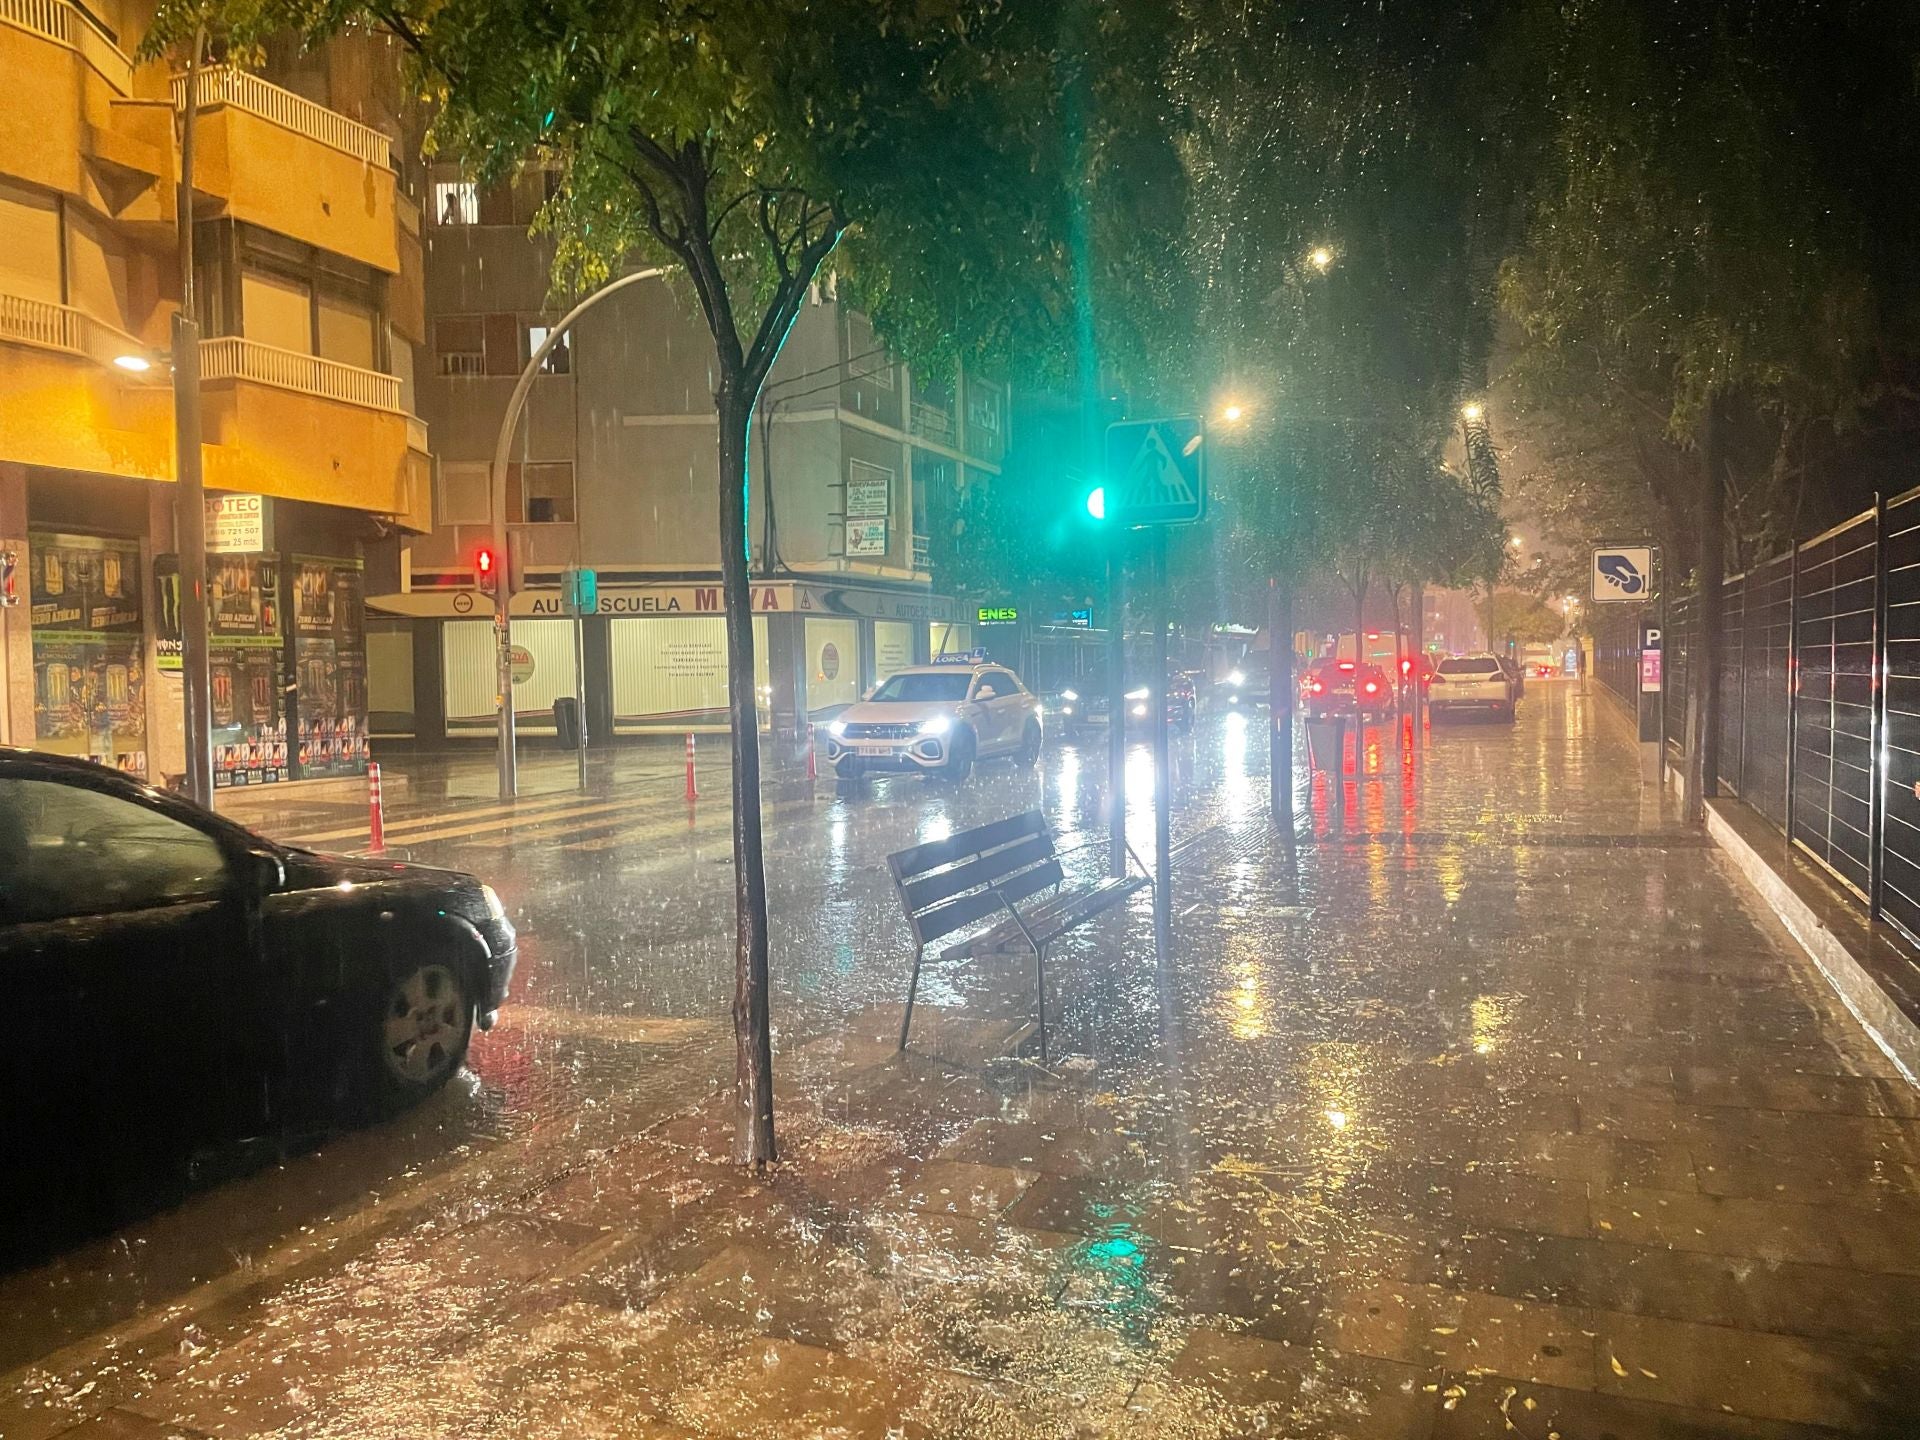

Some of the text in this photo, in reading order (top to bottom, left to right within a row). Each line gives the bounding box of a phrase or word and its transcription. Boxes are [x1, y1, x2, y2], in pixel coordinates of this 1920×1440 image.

[233, 537, 242, 546] 25
[1646, 629, 1661, 646] P
[936, 654, 969, 663] LORCA
